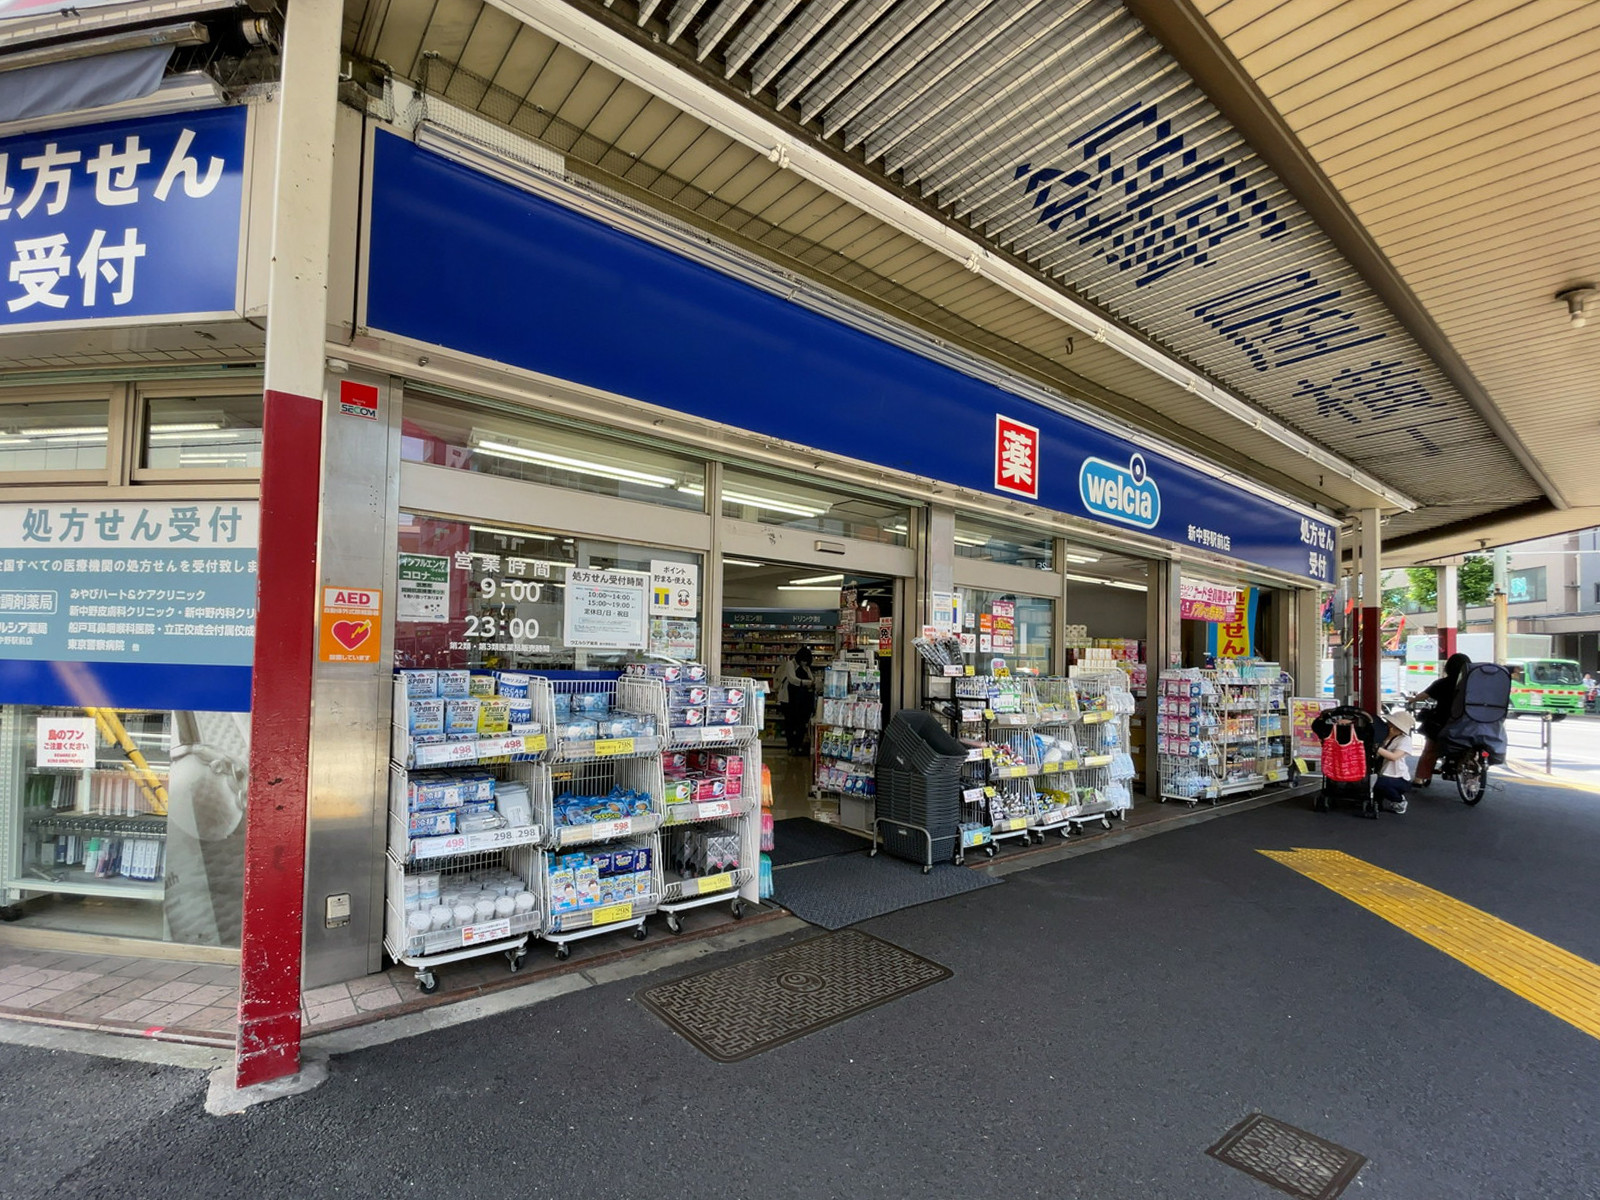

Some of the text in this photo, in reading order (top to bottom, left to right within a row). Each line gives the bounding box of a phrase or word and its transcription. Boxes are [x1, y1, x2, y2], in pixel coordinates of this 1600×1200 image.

[7, 228, 147, 313] 受付
[341, 404, 376, 418] SECOM
[1002, 430, 1033, 487] 薬
[1086, 473, 1153, 521] welcia
[22, 506, 242, 543] 処方せん受付
[1187, 524, 1231, 551] 新中野駅前店
[1300, 517, 1335, 551] 処方せん
[454, 551, 551, 578] 営業時間
[663, 566, 686, 575] ポイント
[1309, 551, 1327, 578] 受付
[402, 571, 431, 580] コロナ
[572, 571, 644, 588] 処方せん受付時間
[480, 578, 541, 602] 9:00
[334, 591, 371, 605] AED
[463, 615, 540, 640] 23:00
[484, 705, 507, 713] SPORTS
[48, 729, 84, 740] 鳥のフン
[44, 742, 89, 751] ご注意ください
[452, 745, 472, 755] 498
[504, 740, 522, 749] 498
[613, 821, 629, 831] 598
[493, 831, 512, 841] 298
[518, 829, 536, 838] 298
[445, 838, 465, 848] 498
